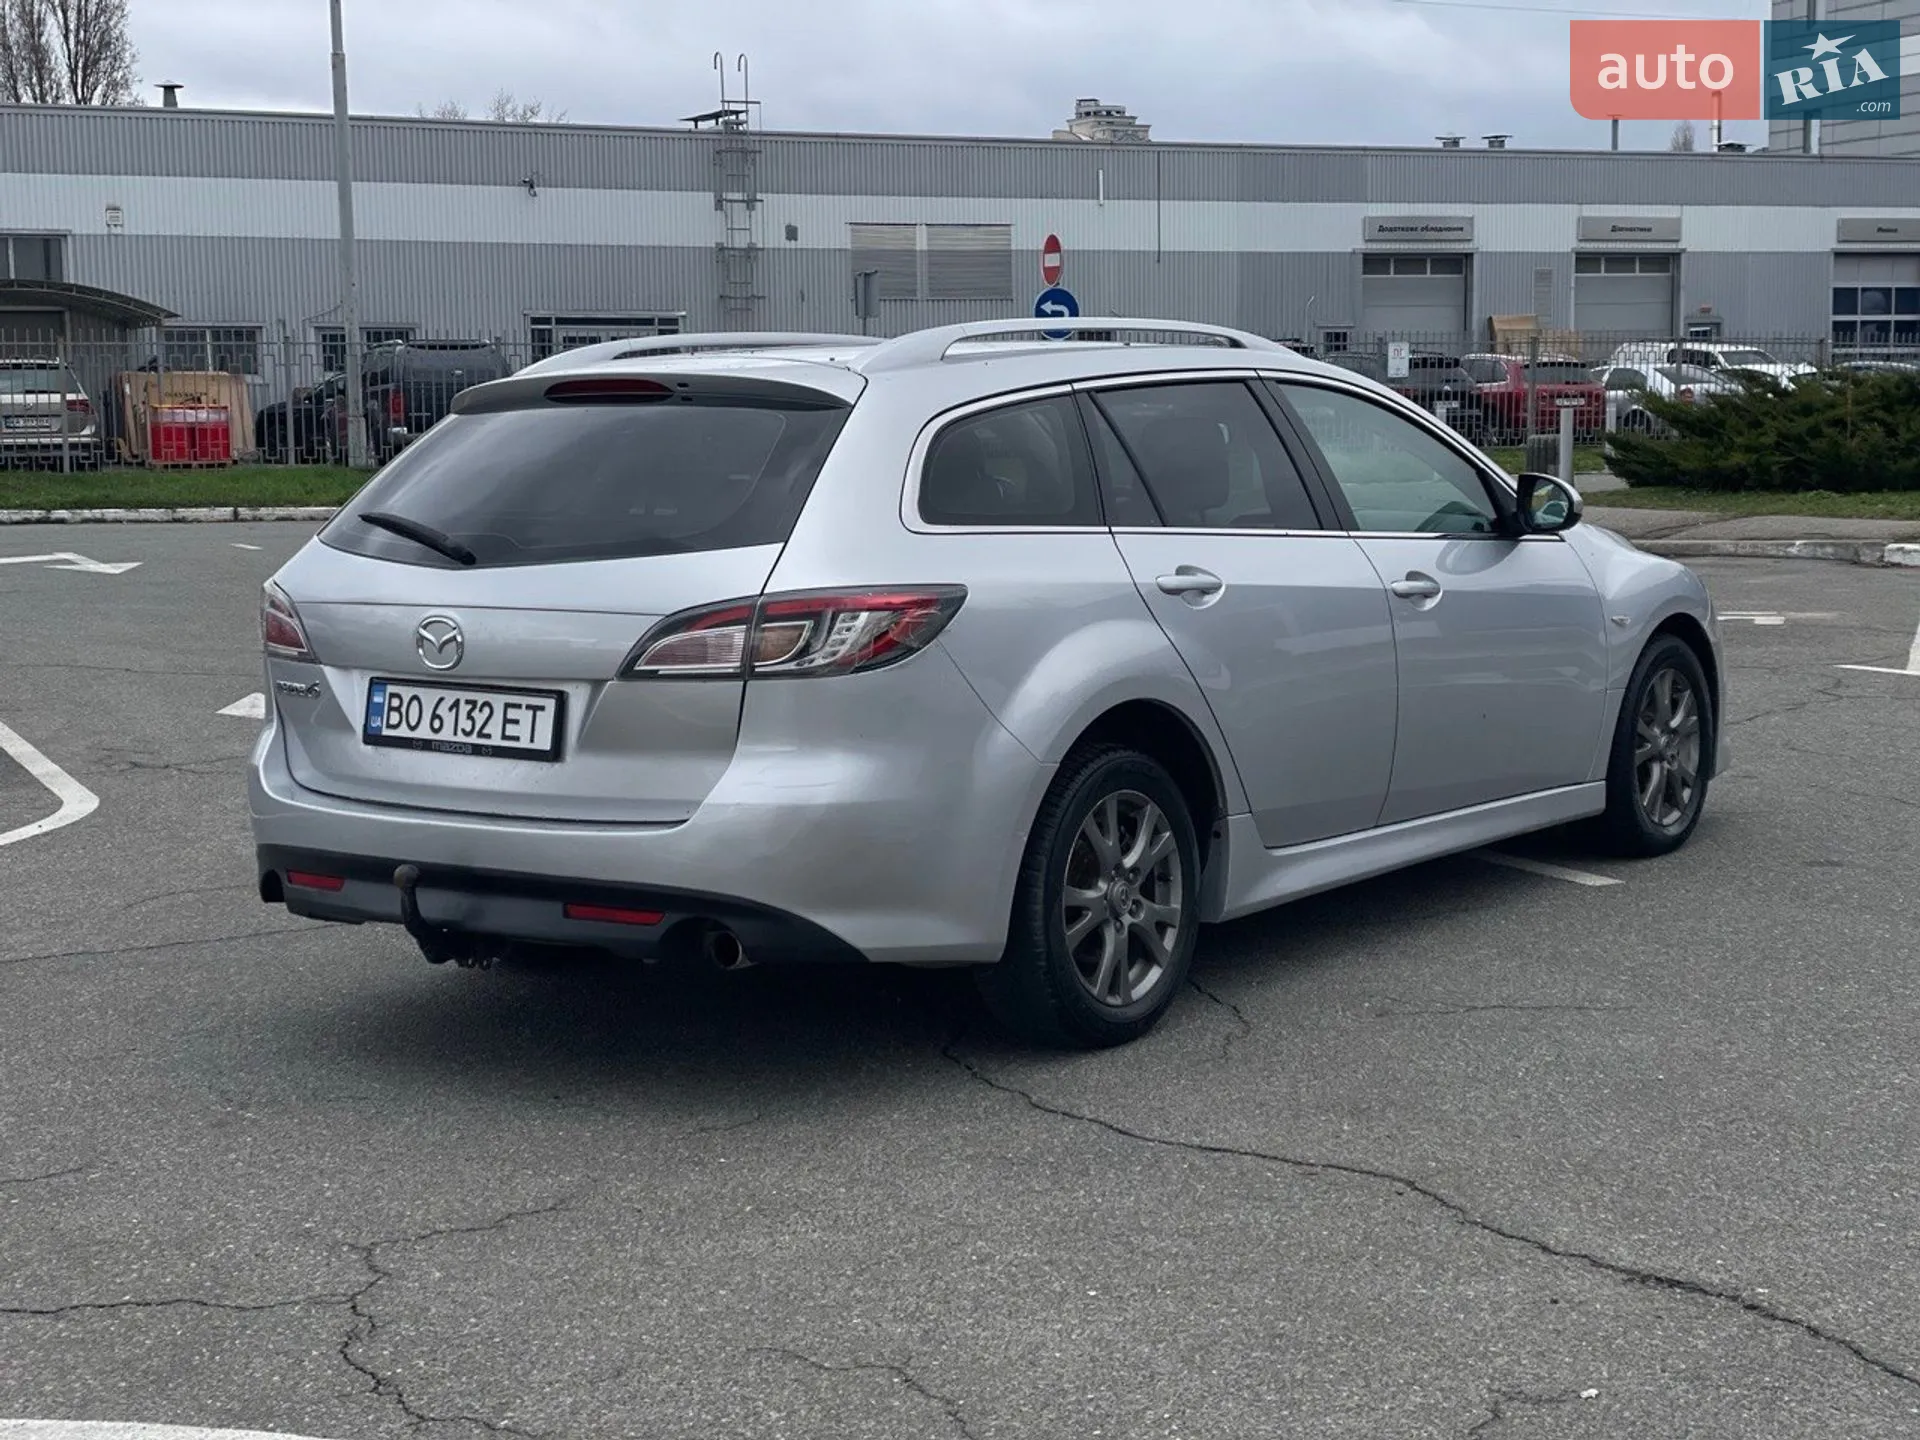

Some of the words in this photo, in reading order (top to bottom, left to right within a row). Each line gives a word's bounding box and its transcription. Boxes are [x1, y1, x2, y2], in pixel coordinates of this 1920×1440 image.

[370, 714, 382, 728] UA
[385, 691, 424, 732] BO
[428, 695, 495, 740] 6132
[500, 701, 546, 744] ET
